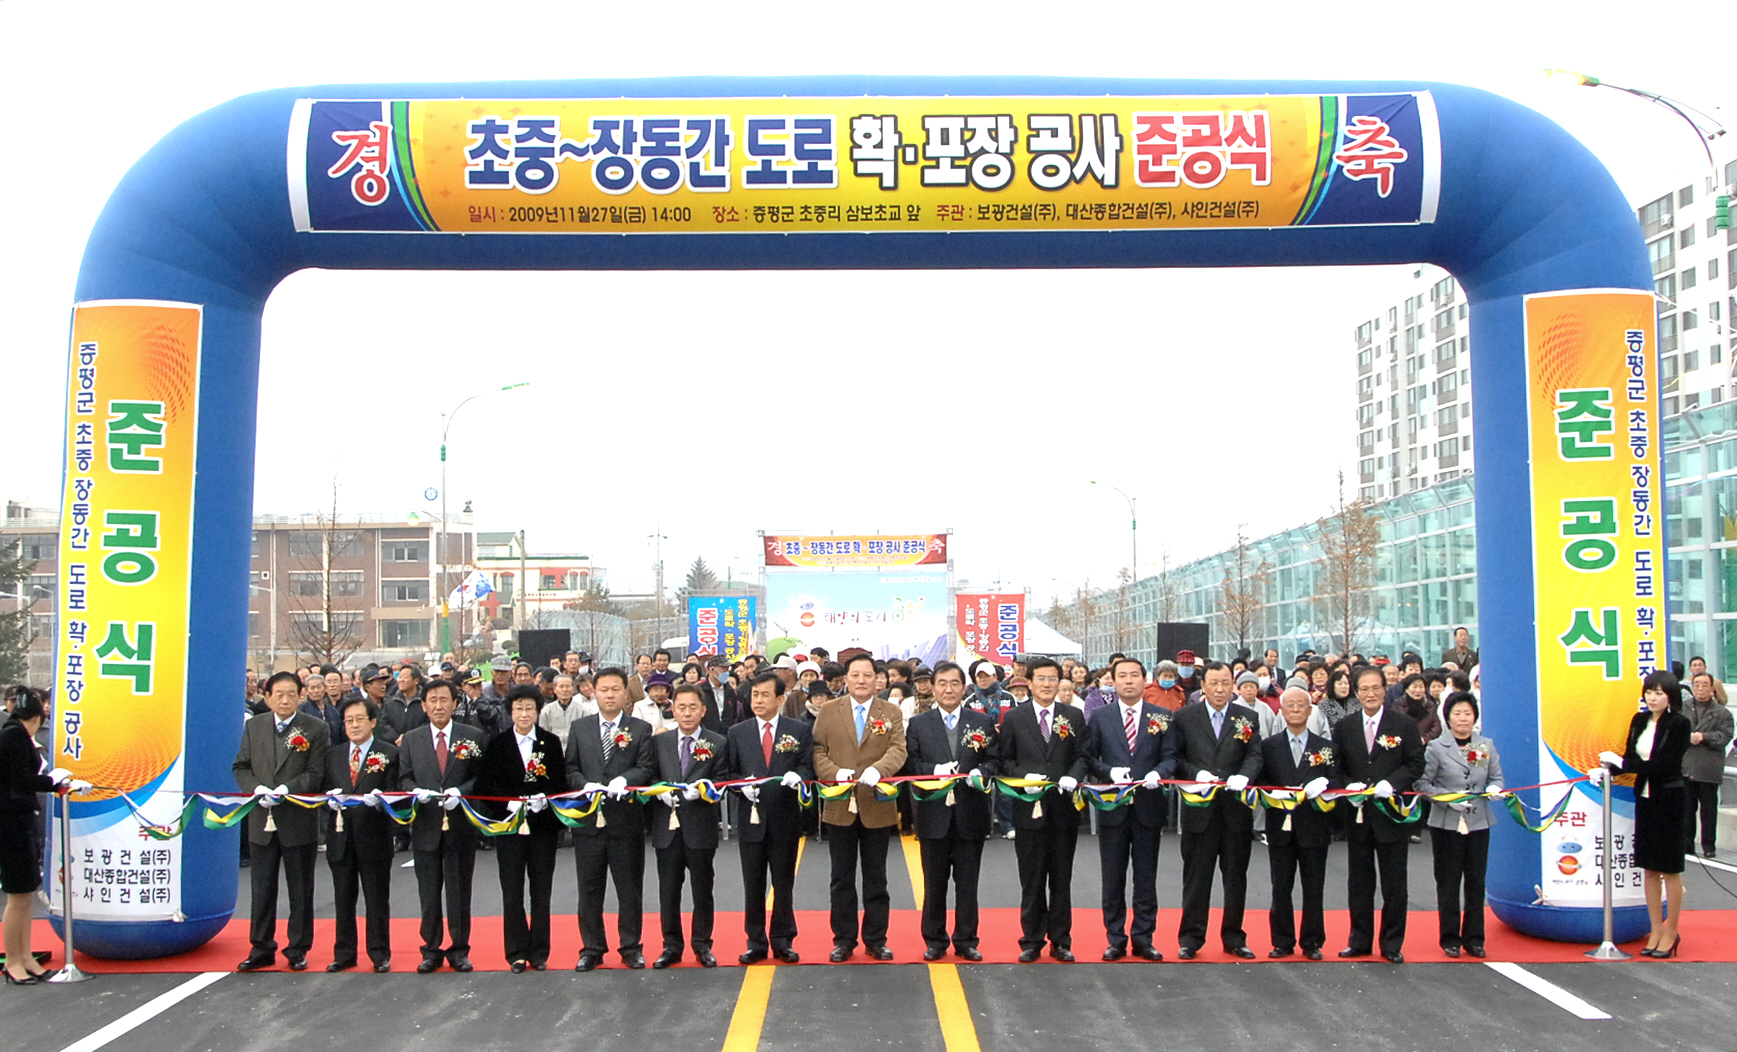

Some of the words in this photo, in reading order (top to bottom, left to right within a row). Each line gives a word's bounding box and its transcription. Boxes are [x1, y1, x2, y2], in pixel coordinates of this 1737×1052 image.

[327, 124, 391, 205] 경
[744, 118, 835, 187] 도로
[1027, 115, 1122, 189] 공사
[1135, 113, 1271, 187] 준공식
[1335, 117, 1405, 197] 축
[509, 206, 647, 223] 2009년11월27일(금)
[652, 207, 691, 222] 14:00
[753, 205, 794, 223] 증평군
[799, 205, 841, 222] 초중리
[846, 204, 902, 222] 삼보초교
[907, 204, 921, 221] 앞
[977, 202, 1061, 221] 보광건설(주),
[1065, 201, 1176, 220] 대산종합건설(주),
[1181, 200, 1260, 219] 샤인건설(주)
[77, 343, 97, 413] 증평군
[1626, 331, 1645, 401] 증평군
[75, 423, 94, 472] 초중
[1629, 410, 1648, 458] 초중
[71, 479, 94, 550] 장동간
[1631, 466, 1652, 536] 장동간
[768, 541, 782, 556] 경
[836, 541, 850, 554] 도로
[885, 540, 900, 554] 공사
[903, 540, 926, 554] 준공식
[69, 565, 87, 610] 도로
[1635, 551, 1653, 596] 도로
[999, 605, 1018, 659] 준공식
[63, 712, 82, 760] 공사
[84, 867, 171, 885] 대산종합건설(주)
